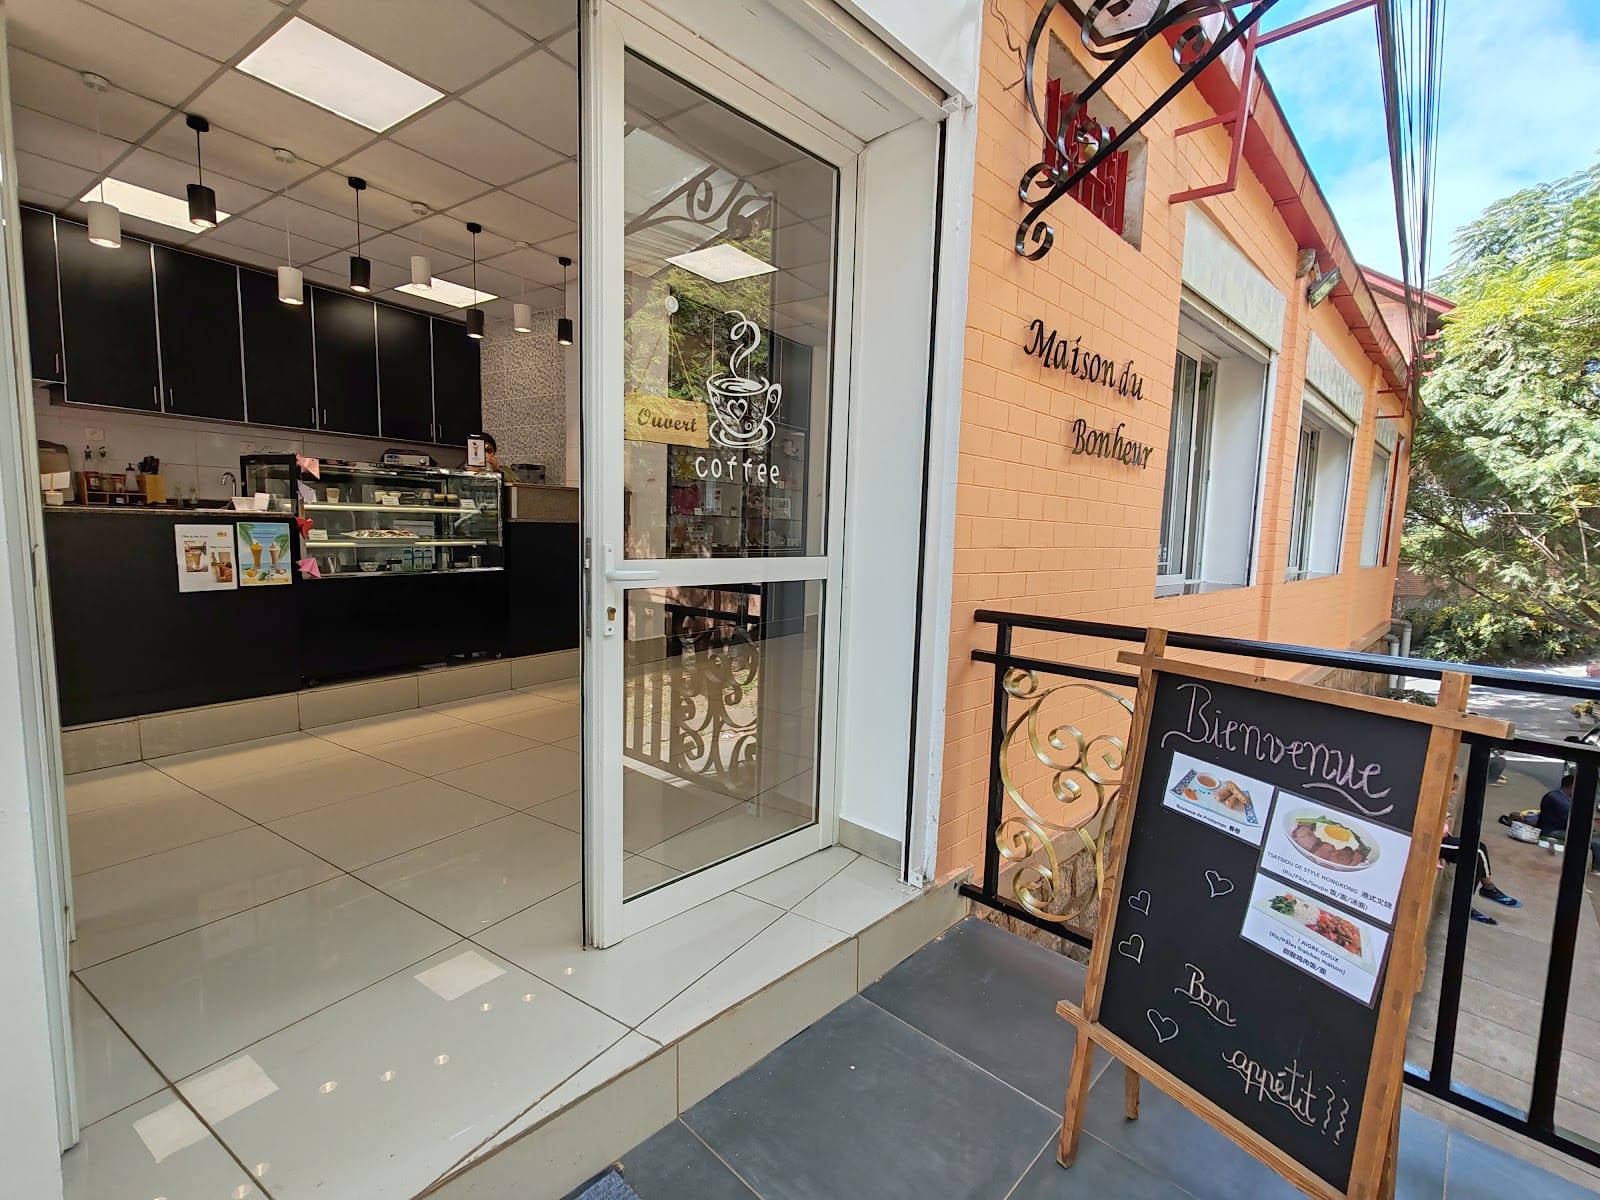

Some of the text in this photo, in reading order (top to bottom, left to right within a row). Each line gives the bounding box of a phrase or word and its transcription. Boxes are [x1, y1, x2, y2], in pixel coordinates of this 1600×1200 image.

[1023, 319, 1144, 400] Maison du
[637, 407, 697, 433] Ouvert
[1071, 418, 1154, 470] Bonheur
[695, 455, 780, 485] coffee
[1160, 682, 1392, 800] Bienvenue
[1303, 866, 1320, 877] STYLE
[1321, 873, 1359, 894] HONGKONG
[1174, 962, 1237, 1023] Bon
